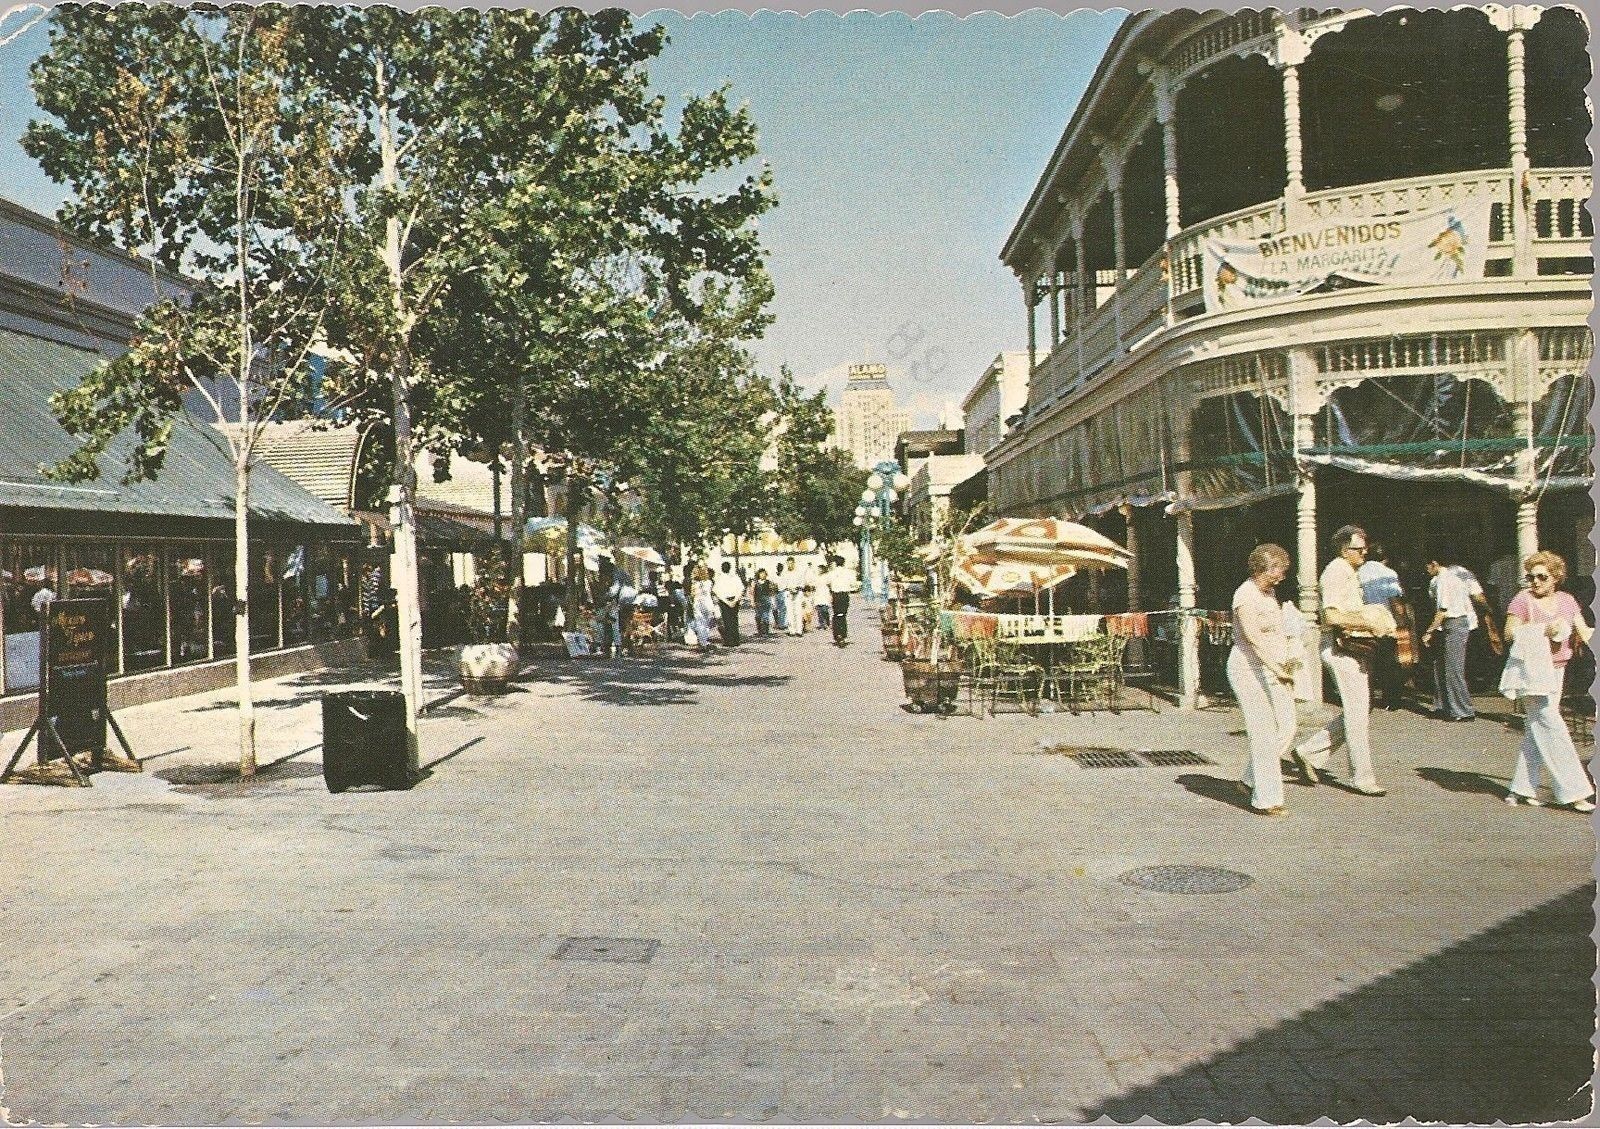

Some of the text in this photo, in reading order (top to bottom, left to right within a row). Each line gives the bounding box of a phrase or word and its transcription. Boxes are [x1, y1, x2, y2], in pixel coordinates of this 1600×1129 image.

[1259, 221, 1402, 258] BIENVENIDOS
[1270, 260, 1289, 275] LA
[1297, 247, 1389, 272] MARGARITA
